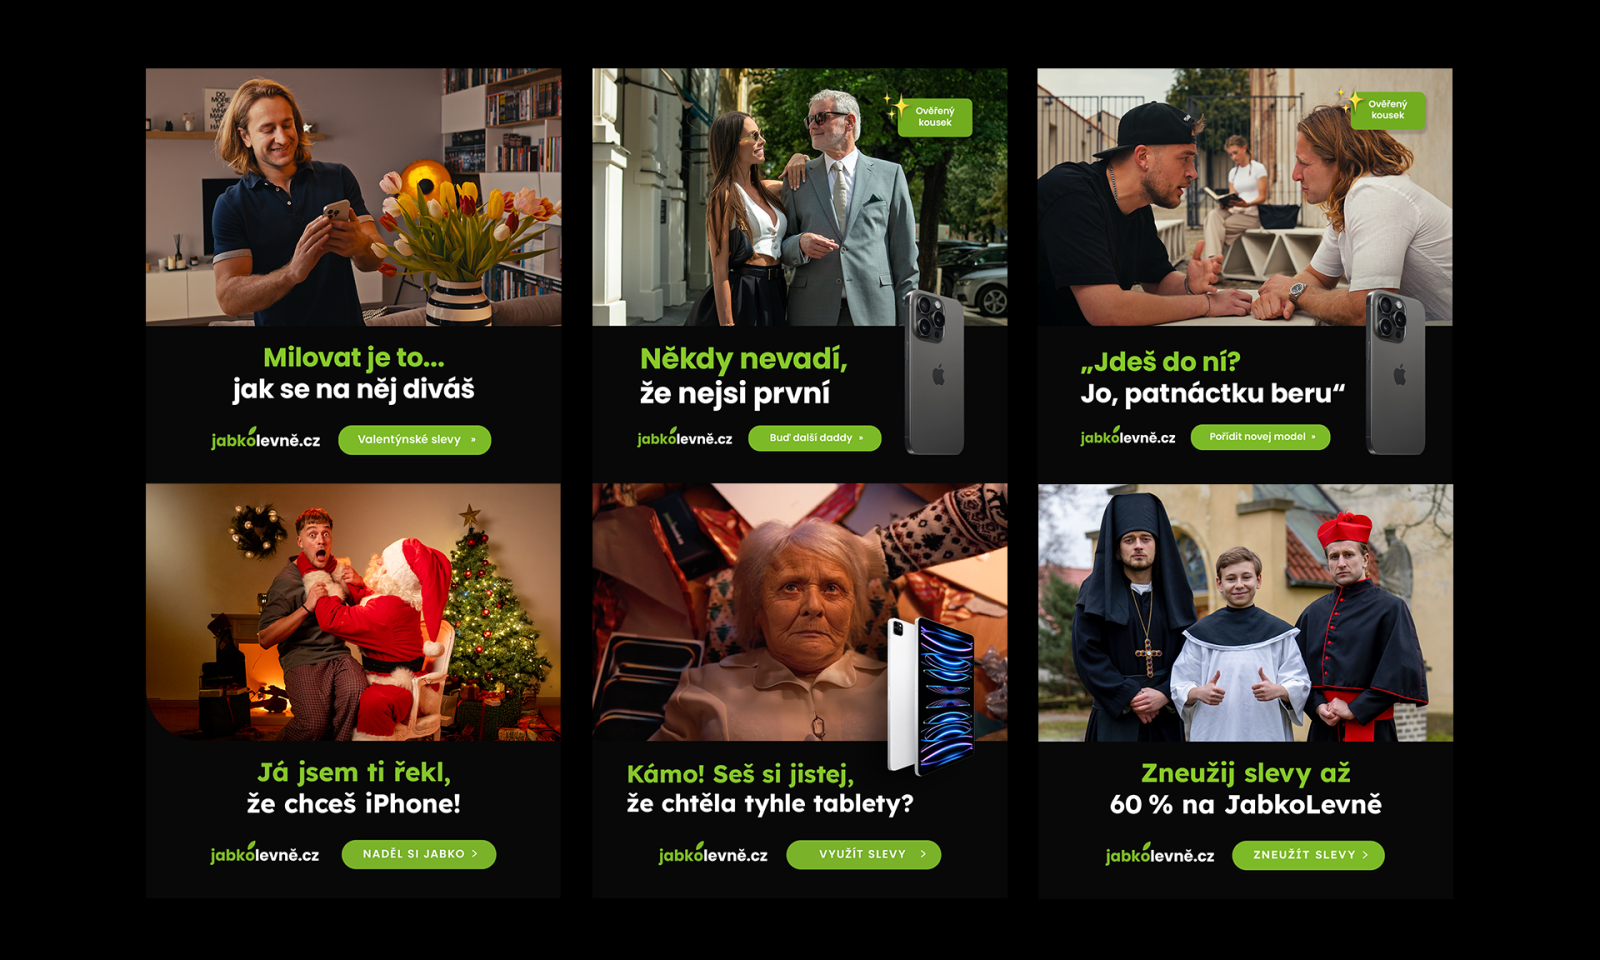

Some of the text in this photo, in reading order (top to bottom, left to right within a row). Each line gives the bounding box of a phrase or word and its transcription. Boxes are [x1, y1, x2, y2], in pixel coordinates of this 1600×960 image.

[915, 106, 955, 117] Ověřený
[1368, 99, 1407, 110] Ověřený
[918, 118, 951, 127] kousek
[1371, 110, 1404, 120] kousek
[265, 345, 444, 374] Milovat je to...
[642, 345, 847, 376] Někdy nevadí,
[1081, 349, 1240, 374] „Jdeš do ní?
[232, 376, 474, 405] jak se na něj diváš
[641, 379, 830, 411] že nejsi první
[1081, 381, 1345, 410] Jo, patnáctku beru“
[211, 432, 320, 450] jabkolevně.cz
[357, 433, 461, 447] Valentýnské slevy
[637, 431, 732, 448] jabkolevně.cz
[769, 432, 852, 445] Buď další daddy
[1080, 430, 1175, 446] jabkolevně.cz
[1209, 431, 1305, 444] Pořídit novej model
[257, 760, 450, 787] Já jsem ti řekl,
[628, 763, 853, 788] Kámo! Seš si jistej,
[1142, 761, 1350, 788] Zneužij slevy až
[247, 791, 460, 813] že chceš iPhone!
[627, 792, 913, 818] že chtěla tyhle tablety?
[1110, 793, 1382, 814] 60 % na JabkoLevně
[210, 847, 319, 865] jabkolevně.cz
[363, 846, 464, 859] NADĚL SI JABKO
[658, 847, 767, 865] jabkolevně.cz
[818, 846, 905, 859] VYUŽÍT SLEVY
[1105, 847, 1214, 866] jabkolevně.cz
[1253, 847, 1355, 860] ZNEUŽÍT SLEVY
